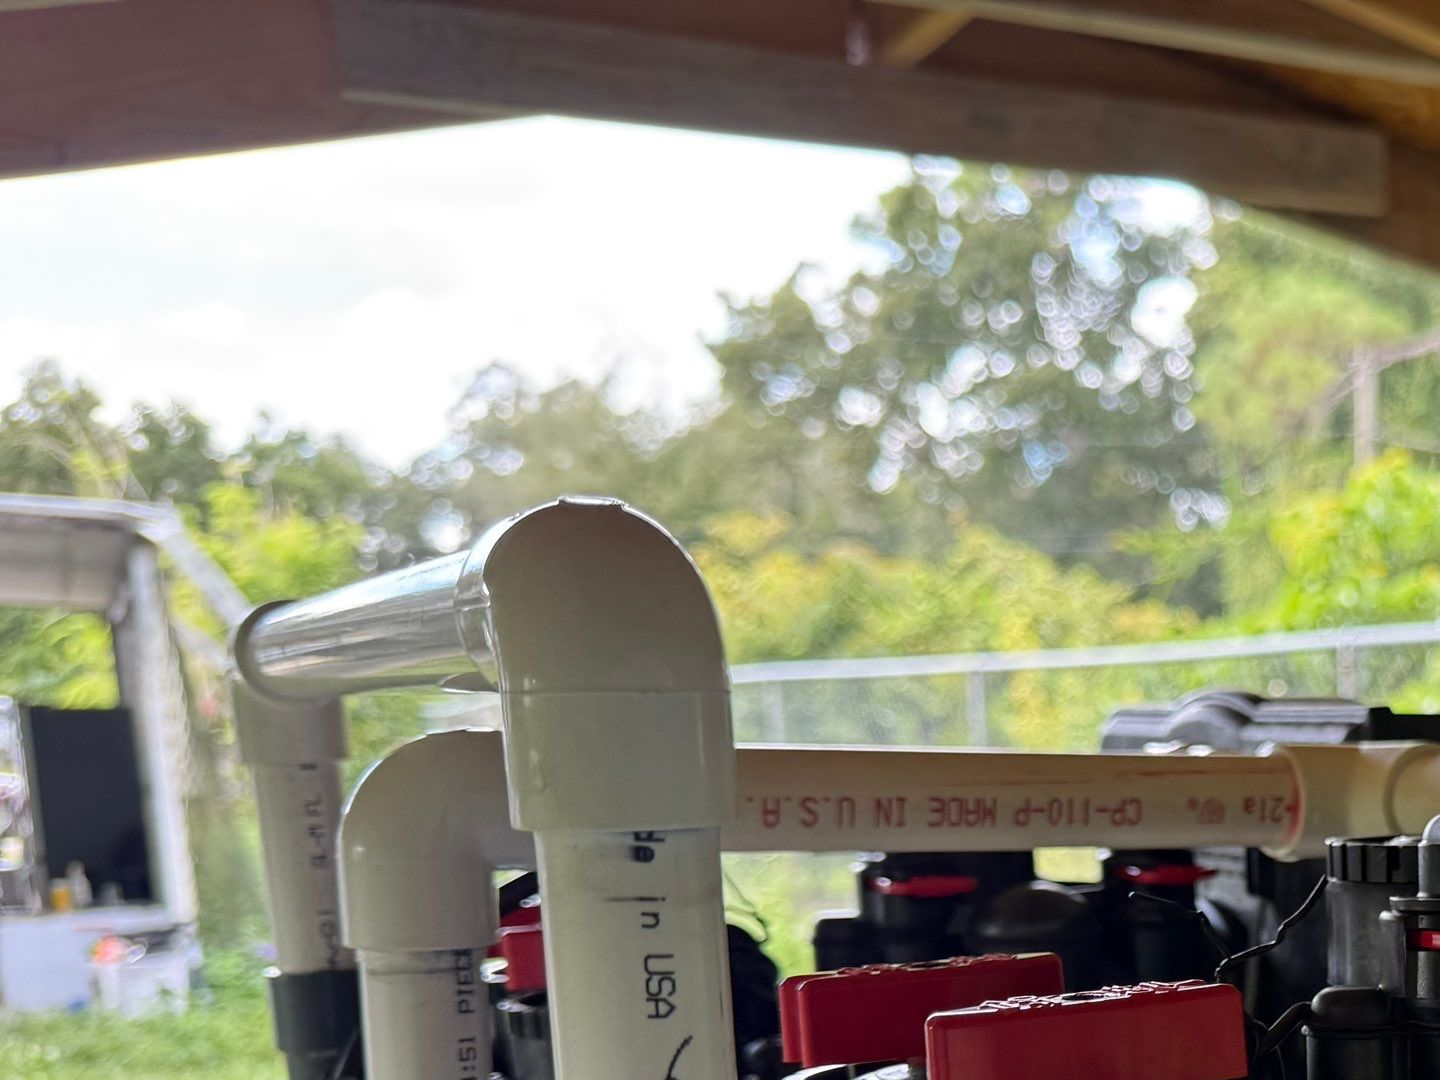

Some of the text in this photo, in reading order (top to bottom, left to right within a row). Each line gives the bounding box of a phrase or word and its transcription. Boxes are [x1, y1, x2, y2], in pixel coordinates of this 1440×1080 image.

[750, 796, 856, 828] U.S.A.
[876, 797, 907, 827] IN
[929, 797, 997, 827] MADE
[1013, 797, 1142, 827] CP-110-P
[641, 896, 665, 928] in
[644, 954, 676, 1019] USA
